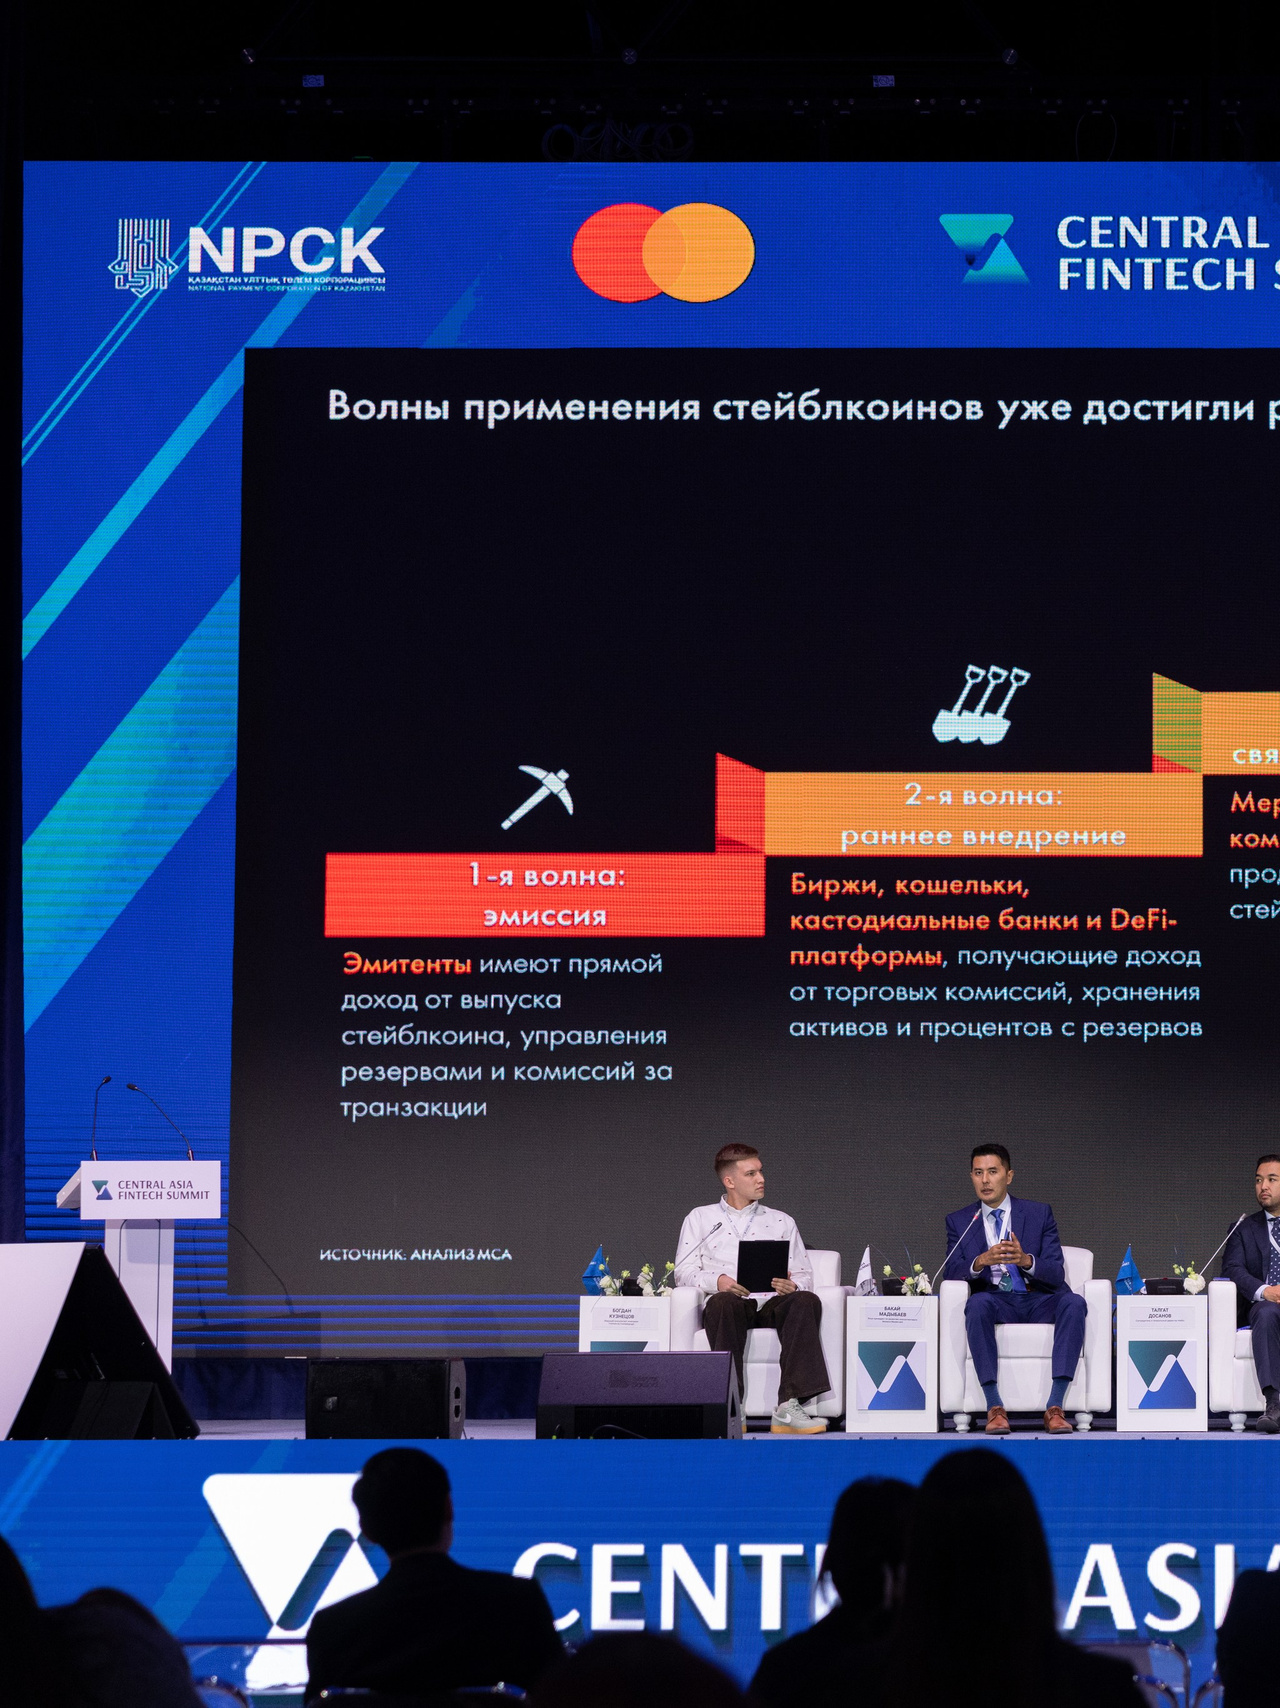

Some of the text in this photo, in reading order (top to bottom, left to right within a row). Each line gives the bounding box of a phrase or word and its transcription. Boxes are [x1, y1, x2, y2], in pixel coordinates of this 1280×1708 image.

[1057, 215, 1270, 249] CENTRAL
[188, 226, 385, 274] NPCK
[1059, 257, 1255, 291] FINTECH
[329, 389, 449, 420] Волны
[464, 398, 700, 430] применения
[712, 388, 984, 421] стейблкоинов
[997, 399, 1072, 430] уже
[1082, 399, 1254, 425] достигли
[904, 782, 1062, 806] 2-я волна:
[841, 829, 1127, 853] раннее внедрение
[470, 861, 625, 887] 1-я волна:
[790, 872, 1030, 902] Биржи, кошельки,
[483, 909, 607, 927] эмиссия
[790, 906, 1178, 934] кастодиальные банки и DeFi-
[343, 951, 662, 980] Эмитенты имеют прямой
[790, 943, 1202, 973] платформы, получающие доход
[340, 993, 562, 1015] доход от выпуска
[789, 981, 1200, 1007] от торговых комиссий, хранения
[341, 1022, 667, 1052] стейблкоина, управления
[789, 1021, 1203, 1043] активов и процентов с резервов
[341, 1060, 673, 1088] резервами и комиссий за
[340, 1101, 487, 1123] транзакции
[117, 1180, 194, 1190] CENTRAL ASIA
[118, 1190, 210, 1200] FINTECH SUMMIT
[319, 1249, 407, 1262] ИСТОЧНИК:
[409, 1249, 475, 1262] АНАЛИЗ
